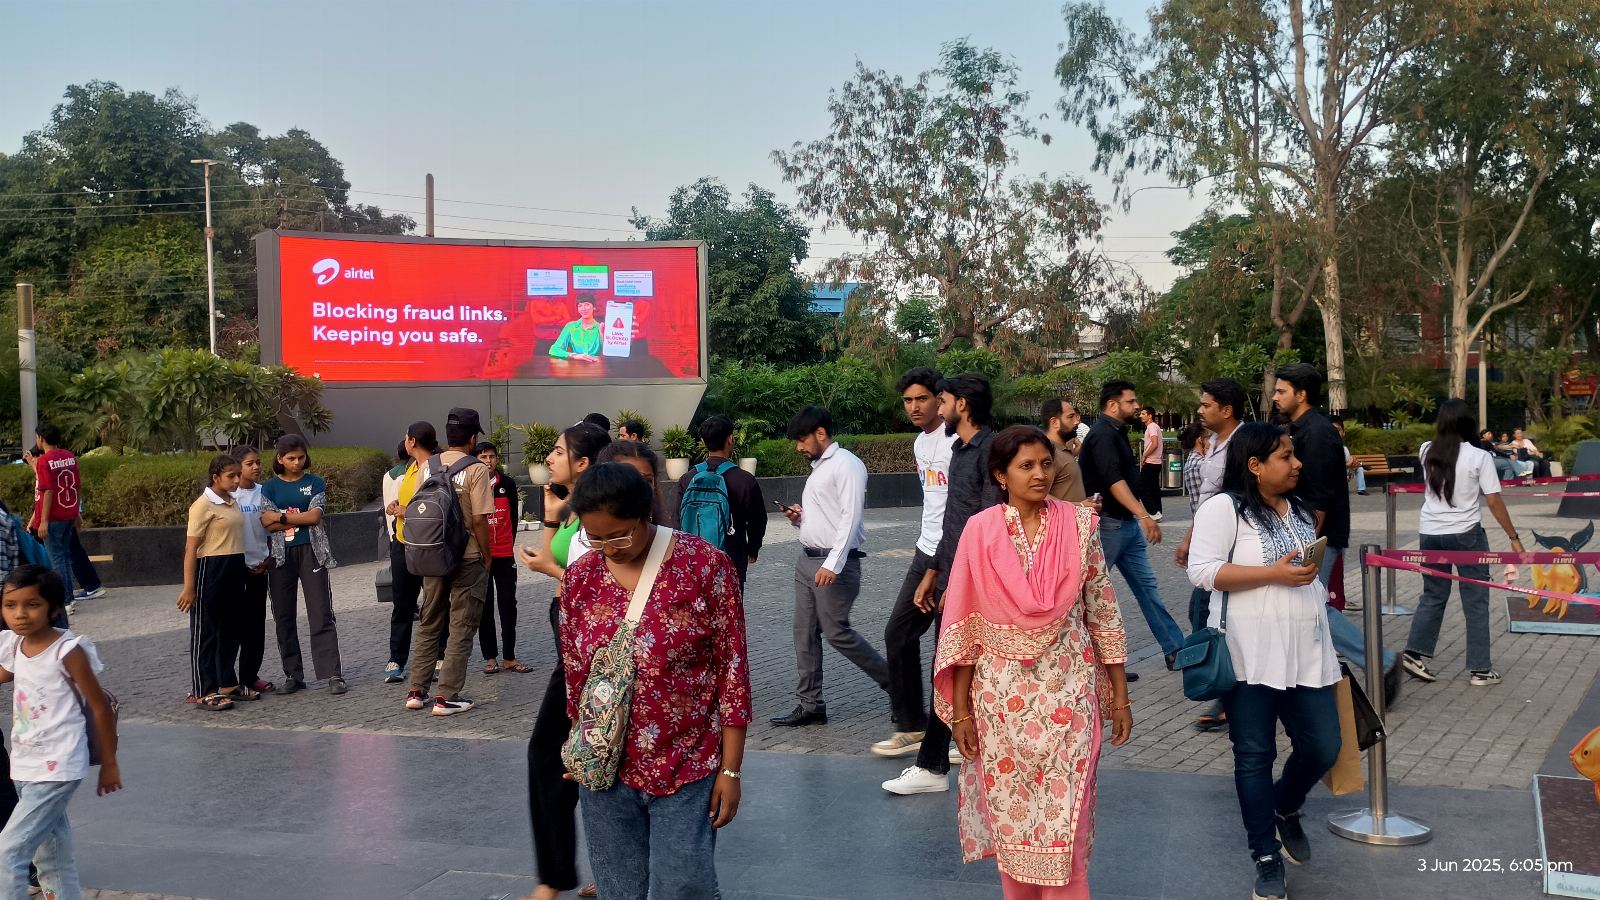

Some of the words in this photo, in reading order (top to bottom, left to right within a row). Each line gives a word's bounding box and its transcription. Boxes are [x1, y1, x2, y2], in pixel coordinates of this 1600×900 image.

[343, 267, 375, 280] airtel
[312, 302, 398, 323] Blocking
[402, 304, 455, 320] fraud
[459, 305, 508, 321] links.
[313, 325, 394, 346] Keeping
[398, 331, 434, 346] you
[439, 327, 483, 343] safe.
[48, 457, 76, 470] Emirates
[57, 469, 78, 508] 8
